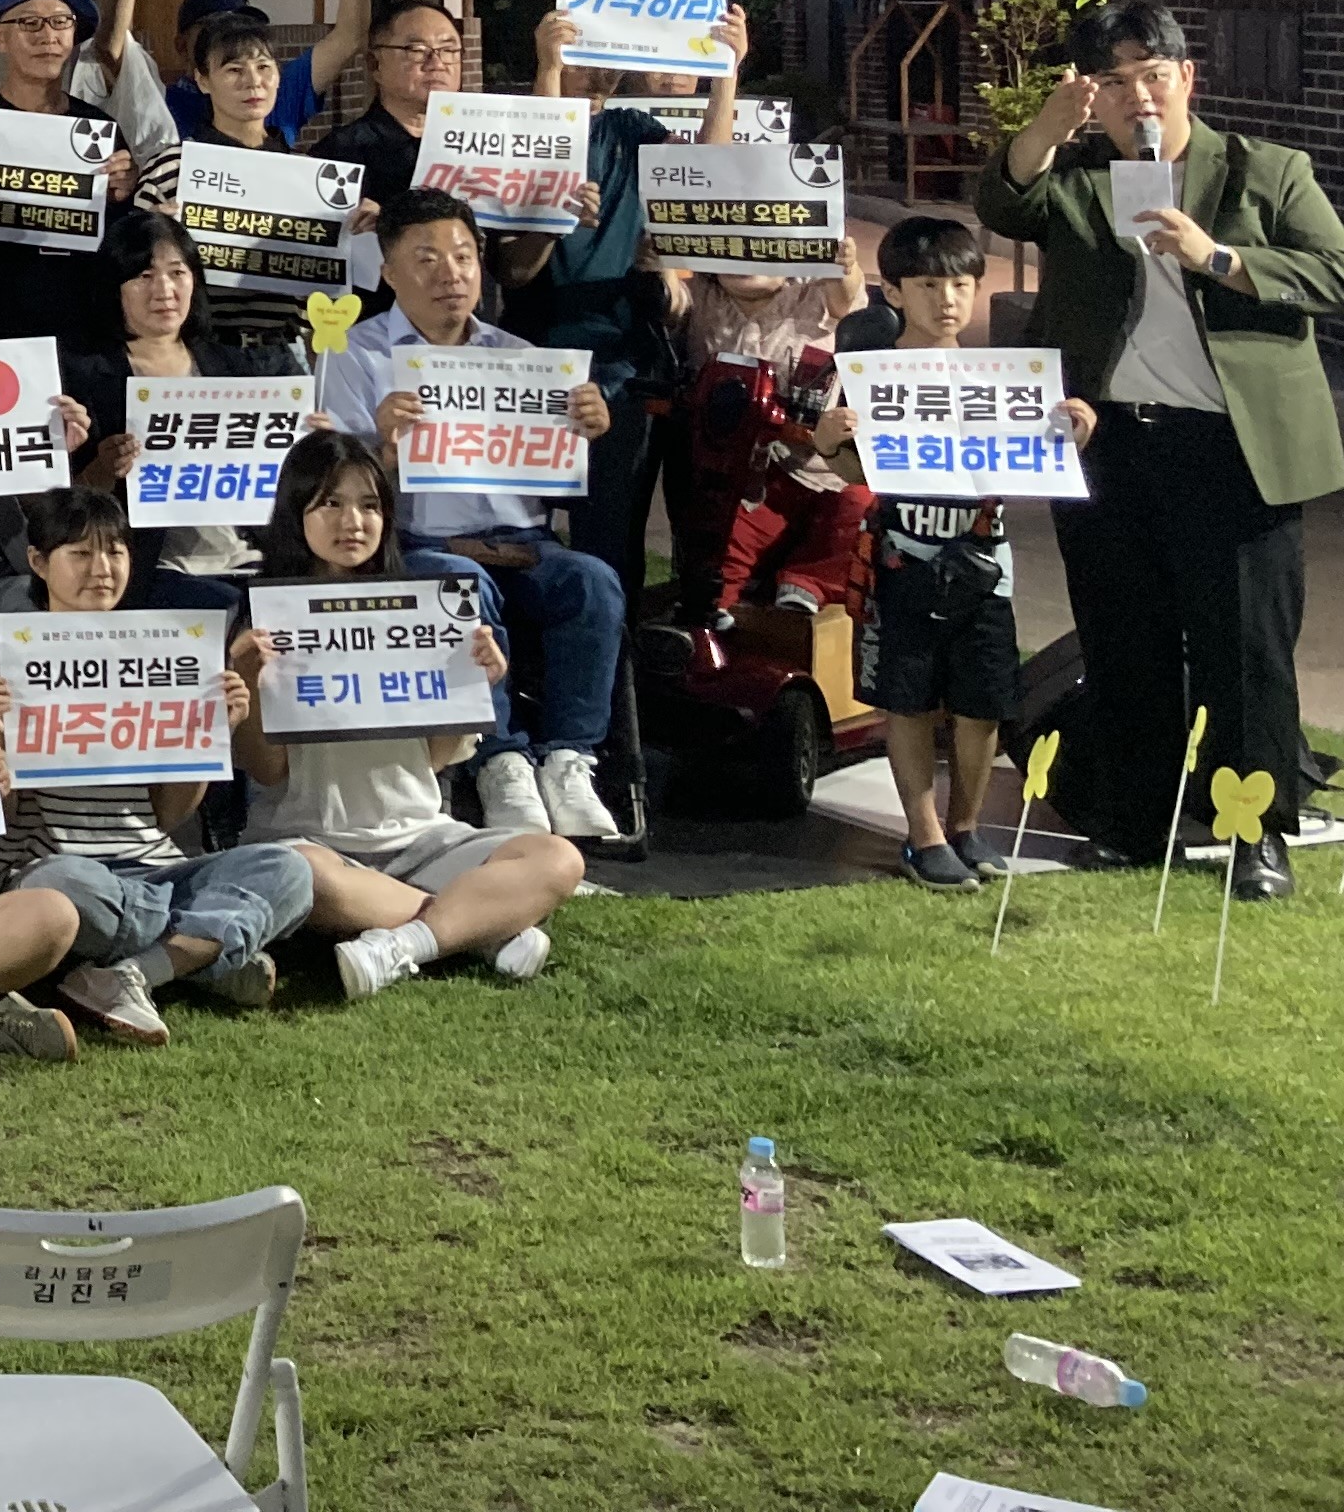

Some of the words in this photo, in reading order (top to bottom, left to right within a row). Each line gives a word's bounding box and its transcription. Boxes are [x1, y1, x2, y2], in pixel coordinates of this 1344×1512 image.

[444, 130, 505, 156] 역사의
[512, 134, 571, 160] 진실을
[28, 172, 79, 195] 오염수
[190, 169, 246, 197] 우리는,
[421, 163, 581, 209] 마주하라!
[650, 166, 712, 188] 우리는,
[21, 205, 92, 232] 반대한다!
[185, 205, 218, 229] 일본
[223, 212, 273, 236] 방사성
[276, 218, 327, 242] 오염수
[651, 202, 687, 223] 일본
[692, 203, 746, 223] 방사성
[753, 204, 811, 224] 오염수
[655, 236, 744, 257] 해양방류를
[750, 238, 832, 259] 반대한다!
[269, 252, 339, 280] 반대한다!
[417, 384, 485, 411] 역사의
[494, 387, 569, 416] 진실을
[870, 384, 1044, 422] 방류결정
[144, 412, 300, 450] 방류결정
[408, 422, 580, 469] 마주하라!
[871, 434, 1065, 472] 철회하라!
[269, 627, 376, 656] 후쿠시마
[386, 623, 463, 649] 오염수
[25, 658, 108, 690] 역사의
[118, 656, 200, 688] 진실을
[296, 673, 362, 708] 투기
[379, 669, 448, 703] 반대
[16, 699, 216, 755] 마주하라!
